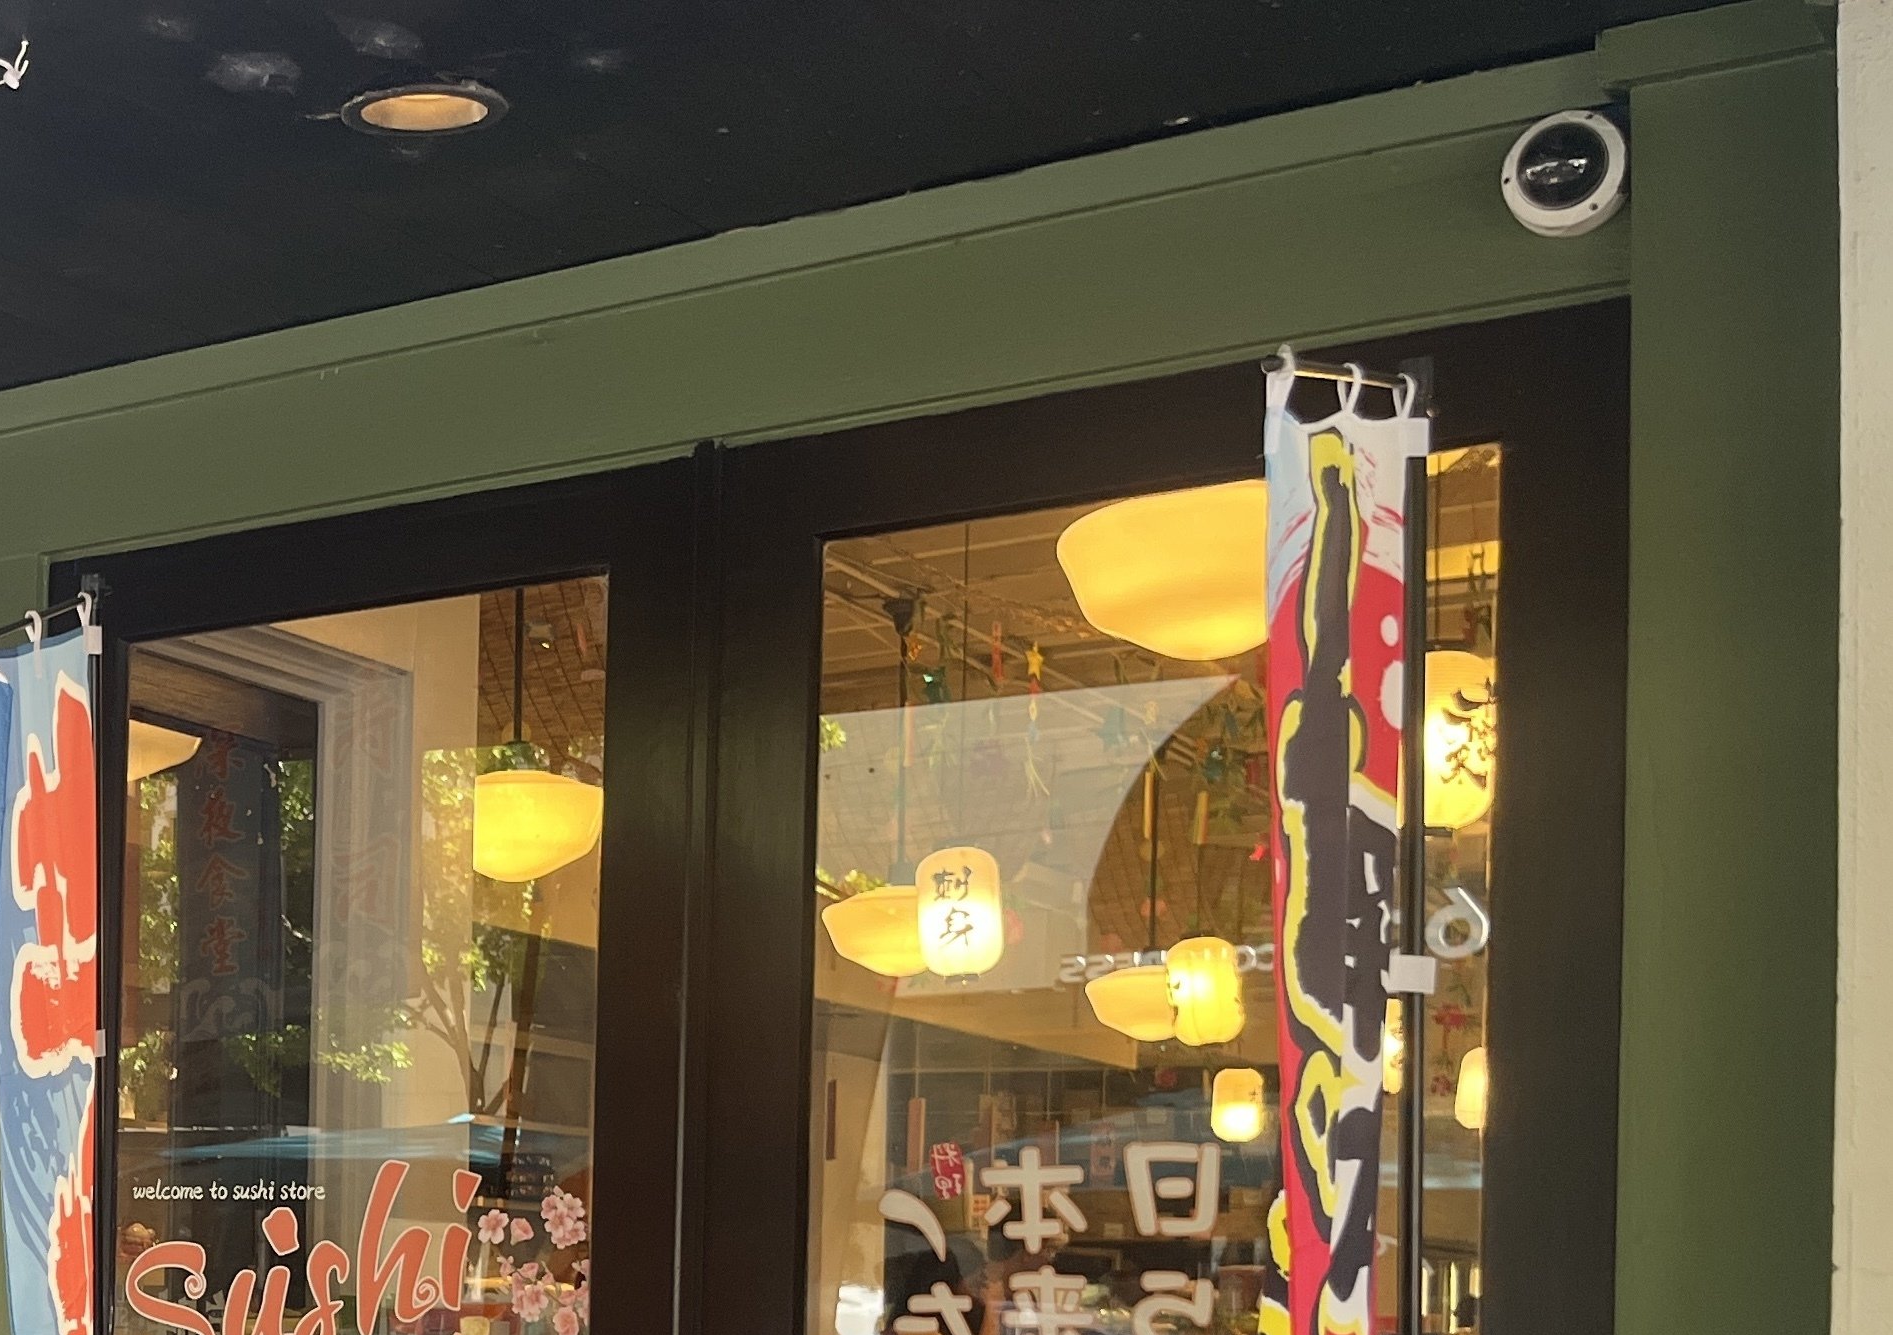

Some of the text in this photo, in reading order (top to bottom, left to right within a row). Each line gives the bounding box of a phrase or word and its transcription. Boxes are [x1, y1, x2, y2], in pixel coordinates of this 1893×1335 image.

[133, 1179, 326, 1202] welcome to sushi store
